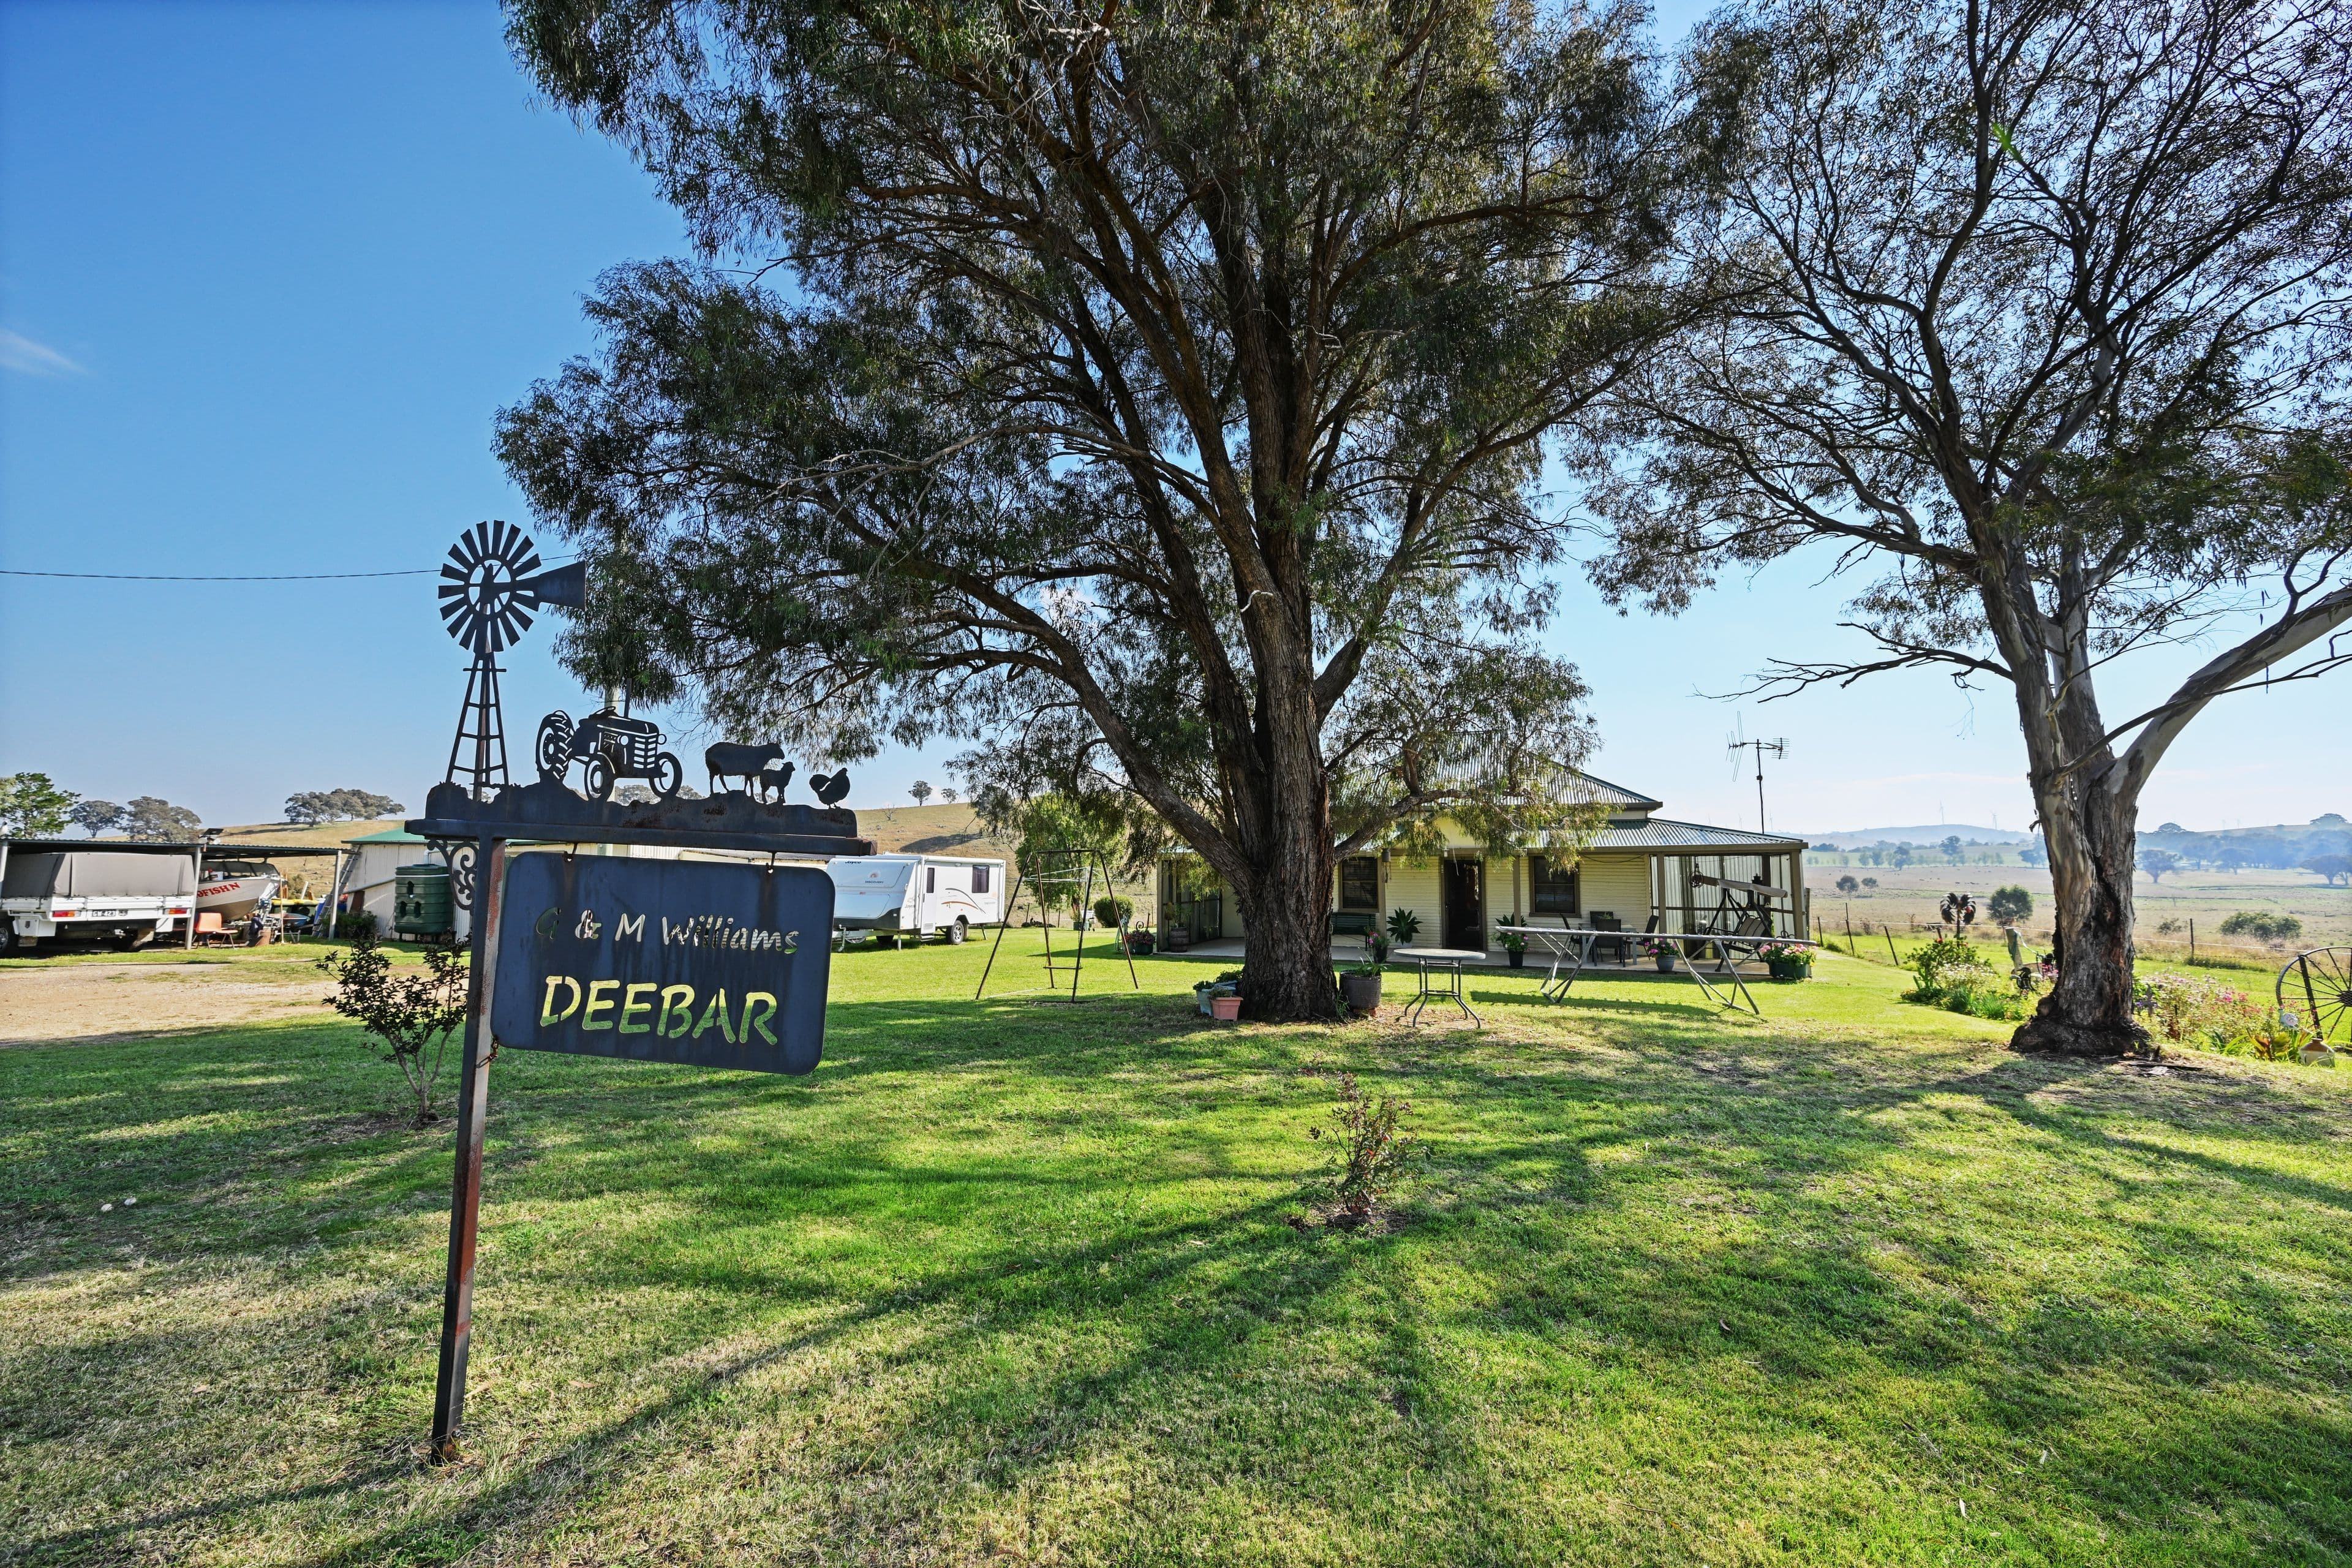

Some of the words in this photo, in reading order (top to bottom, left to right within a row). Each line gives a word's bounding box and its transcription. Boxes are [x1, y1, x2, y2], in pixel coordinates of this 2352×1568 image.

[575, 909, 601, 940] &
[614, 913, 646, 943] M
[662, 914, 799, 954] Williams
[540, 975, 778, 1046] DEEBAR
